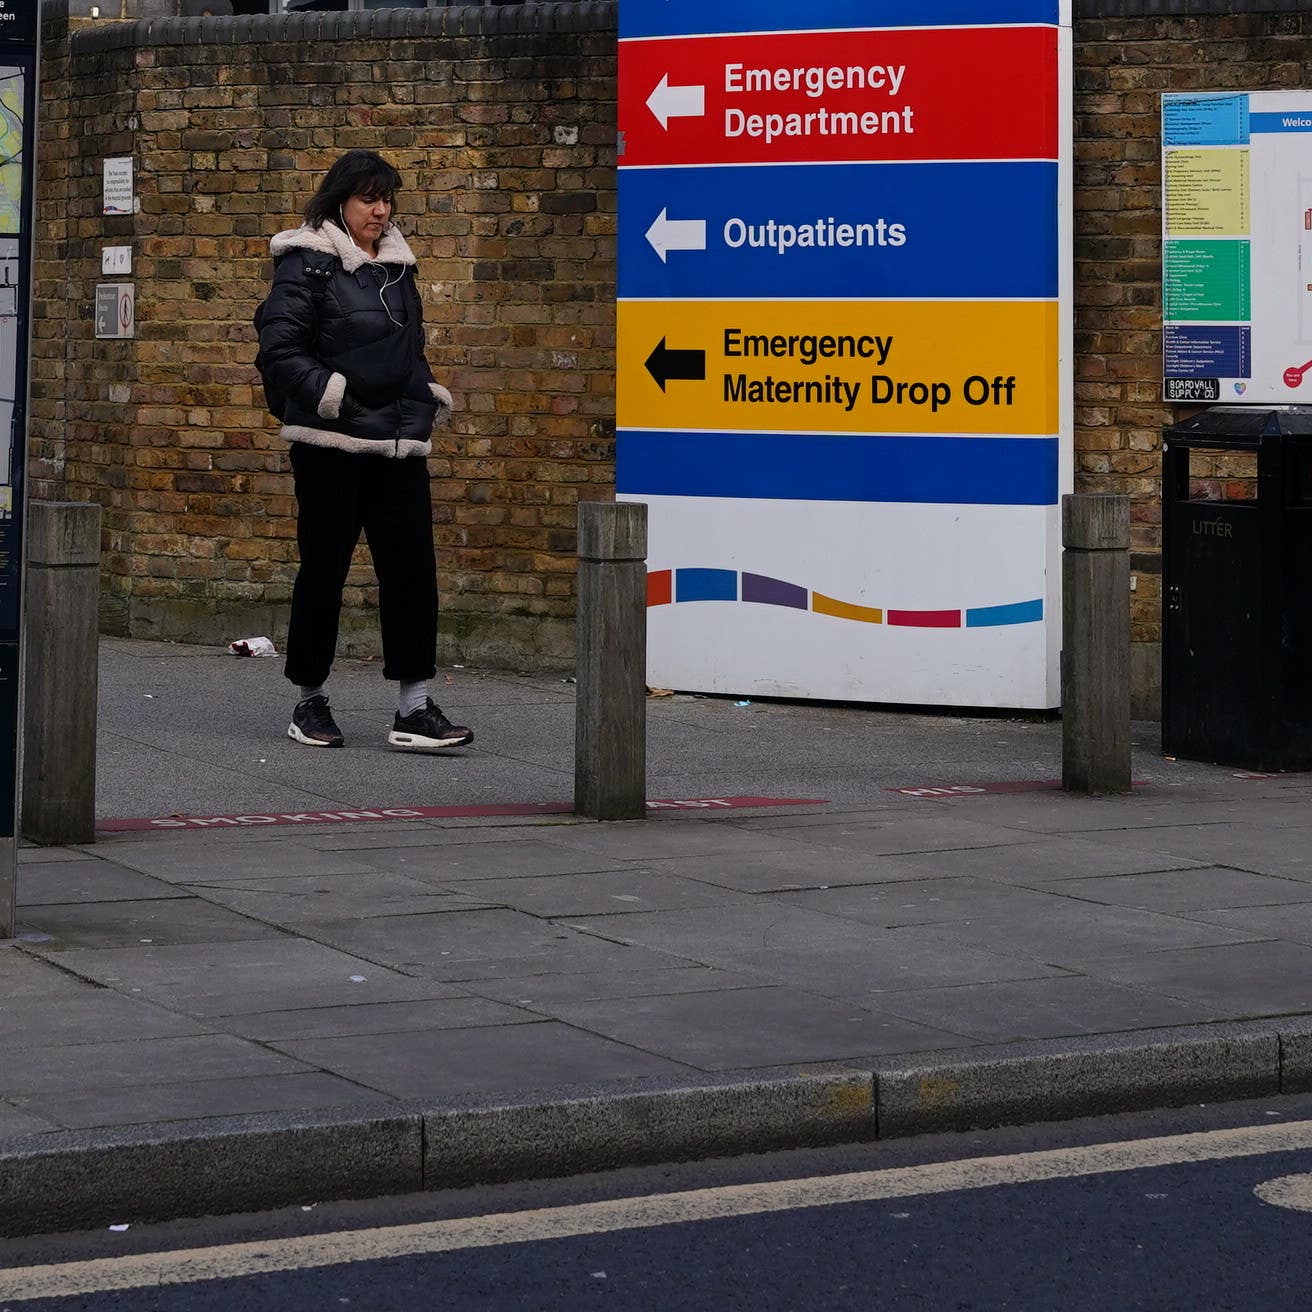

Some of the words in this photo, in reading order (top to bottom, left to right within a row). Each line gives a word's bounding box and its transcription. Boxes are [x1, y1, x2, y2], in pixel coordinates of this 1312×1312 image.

[725, 63, 906, 98] Emergency
[725, 105, 914, 143] Department
[724, 217, 907, 254] Outpatients
[724, 329, 893, 365] Emergency
[724, 374, 860, 411] Maternity
[871, 376, 951, 412] Drop
[963, 376, 1016, 406] Off
[1170, 390, 1200, 398] SUPPLY
[1192, 519, 1232, 537] LITTER
[151, 808, 425, 829] SMOKING
